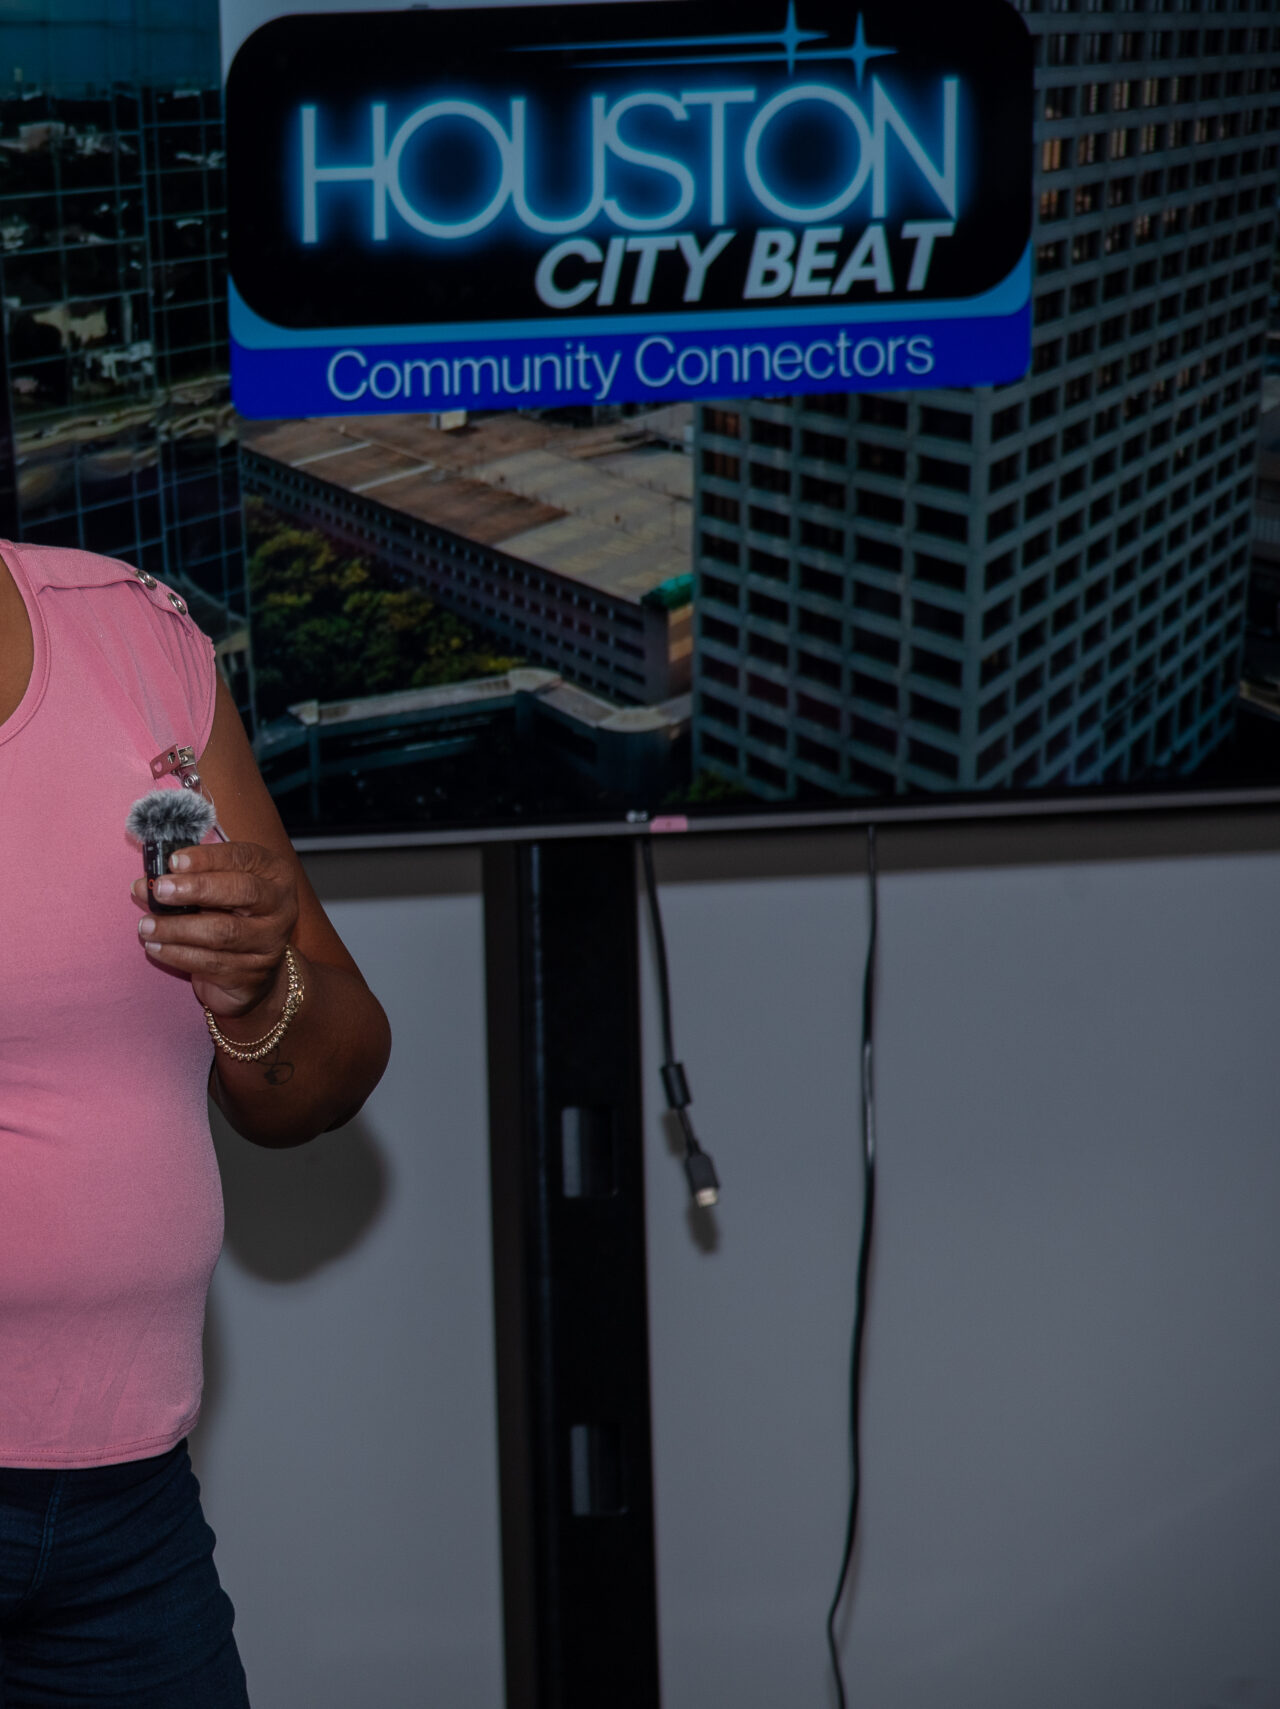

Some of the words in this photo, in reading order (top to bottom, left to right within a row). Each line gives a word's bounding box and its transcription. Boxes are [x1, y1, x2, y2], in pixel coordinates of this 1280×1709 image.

[301, 75, 959, 243] HOUSTON
[534, 228, 736, 308] CITY
[743, 220, 956, 300] BEAT
[327, 342, 620, 401] Community
[635, 331, 935, 390] Connectors
